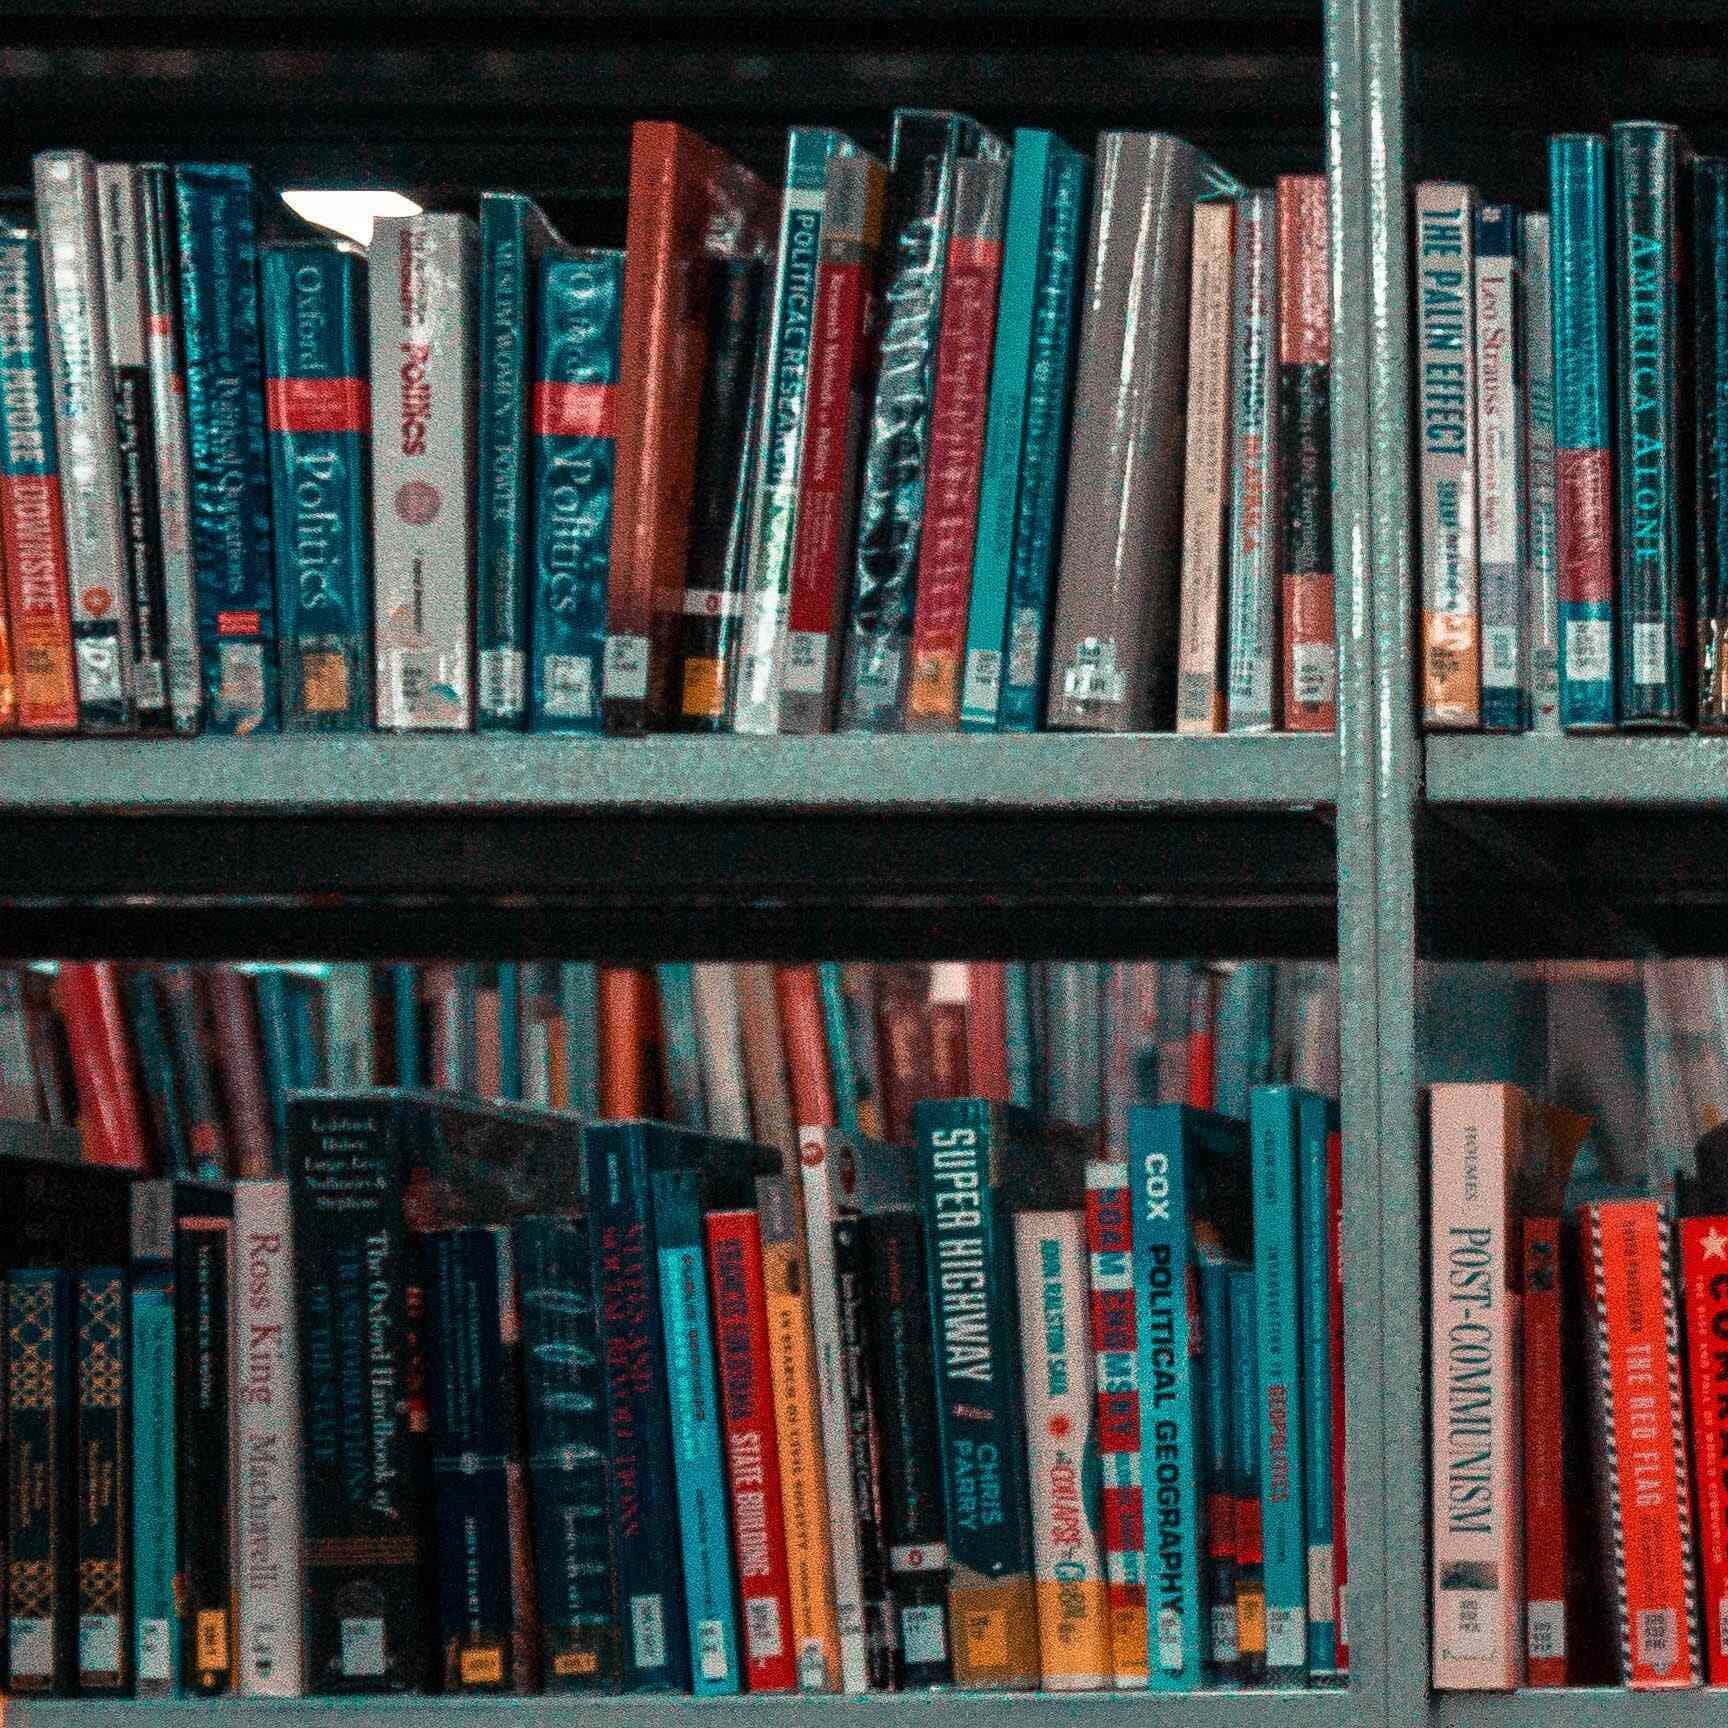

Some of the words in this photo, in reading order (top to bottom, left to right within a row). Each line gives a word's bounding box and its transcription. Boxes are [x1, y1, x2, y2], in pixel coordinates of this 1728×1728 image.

[781, 214, 815, 339] POLITICAL
[1423, 208, 1463, 257] THE
[0, 245, 35, 355] MICHAEL
[296, 267, 330, 371] Oxford
[1423, 270, 1464, 350] PALIN
[1481, 276, 1503, 322] Leo
[1630, 233, 1662, 413] AMERICA
[4, 368, 44, 464] MOORE
[771, 348, 804, 486] RESEARCH
[1426, 362, 1466, 458] EFFECT
[1482, 327, 1503, 415] Strauss
[295, 450, 339, 610] Politics
[1632, 433, 1663, 564] ALONE
[16, 486, 59, 610] DOWNSIZE
[932, 1128, 984, 1230] SUPER
[1145, 1152, 1169, 1221] COX
[250, 1233, 281, 1310] Ross
[367, 1231, 391, 1275] The
[367, 1281, 391, 1361] Oxford
[938, 1239, 993, 1383] HIGHWAY
[1148, 1245, 1178, 1402] POLITICAL
[242, 1324, 283, 1404] King
[1449, 1227, 1493, 1534] POST-COMMUNISM
[1625, 1344, 1652, 1385] THE
[370, 1368, 393, 1482] Handbook
[729, 1431, 763, 1485] STATE
[1628, 1395, 1656, 1444] RED
[248, 1433, 279, 1590] Machiavelli
[370, 1489, 396, 1519] of
[953, 1439, 978, 1530] PARRY
[979, 1443, 1003, 1525] CHRIS
[1153, 1421, 1185, 1613] GEOGRAPHY
[1632, 1450, 1661, 1506] FLAG
[735, 1491, 770, 1577] BUILDING
